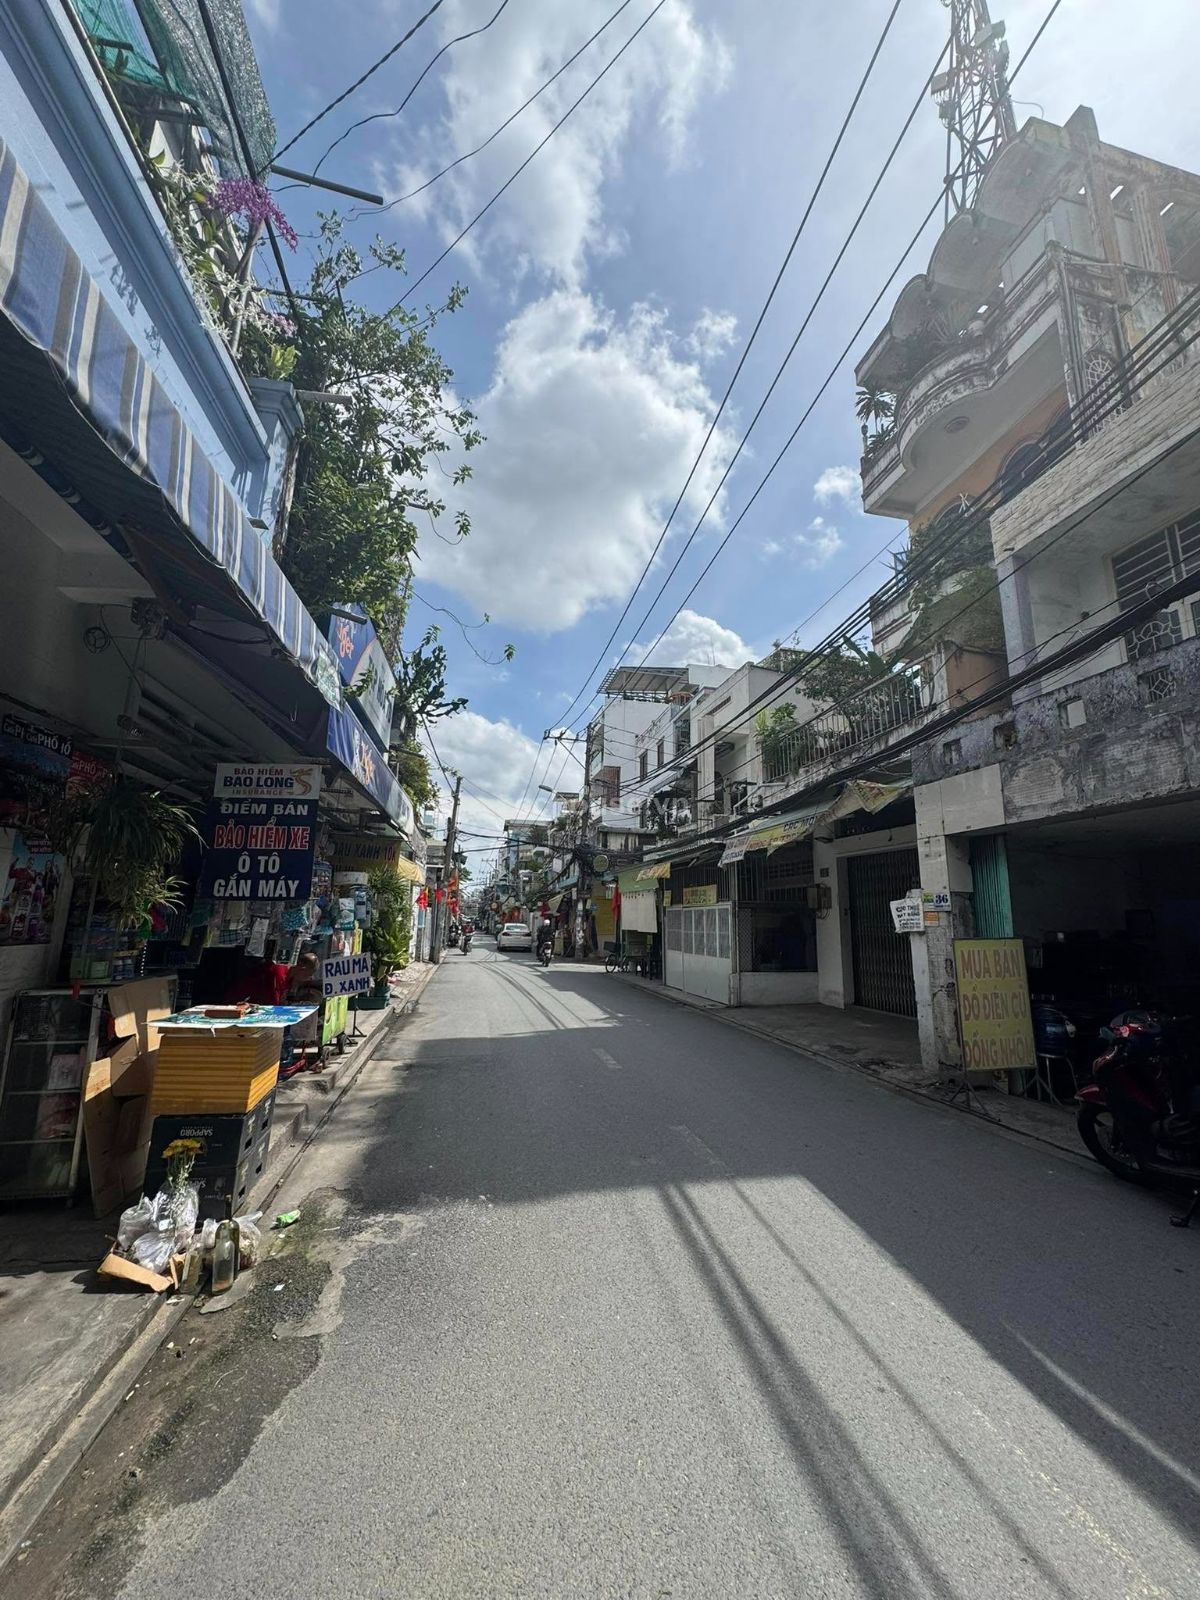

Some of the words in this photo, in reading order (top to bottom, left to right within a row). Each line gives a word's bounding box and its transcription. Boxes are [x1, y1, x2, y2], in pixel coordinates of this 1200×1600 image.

[255, 777, 295, 789] LONG
[219, 799, 267, 815] ĐIỂM
[273, 801, 309, 816] BÁN
[214, 818, 245, 849] BẢO
[247, 816, 288, 850] HIỂM
[288, 826, 311, 850] XE
[238, 851, 251, 874] Ô
[257, 851, 281, 874] TÔ
[213, 872, 252, 897] GẮN
[257, 875, 300, 898] MÁY
[935, 894, 949, 904] 36
[324, 959, 350, 978] RAU
[352, 953, 369, 975] MÁ
[960, 948, 992, 979] MUA
[993, 941, 1022, 980] BÁN
[340, 976, 370, 993] XANH
[180, 1128, 213, 1137] SAPPORO
